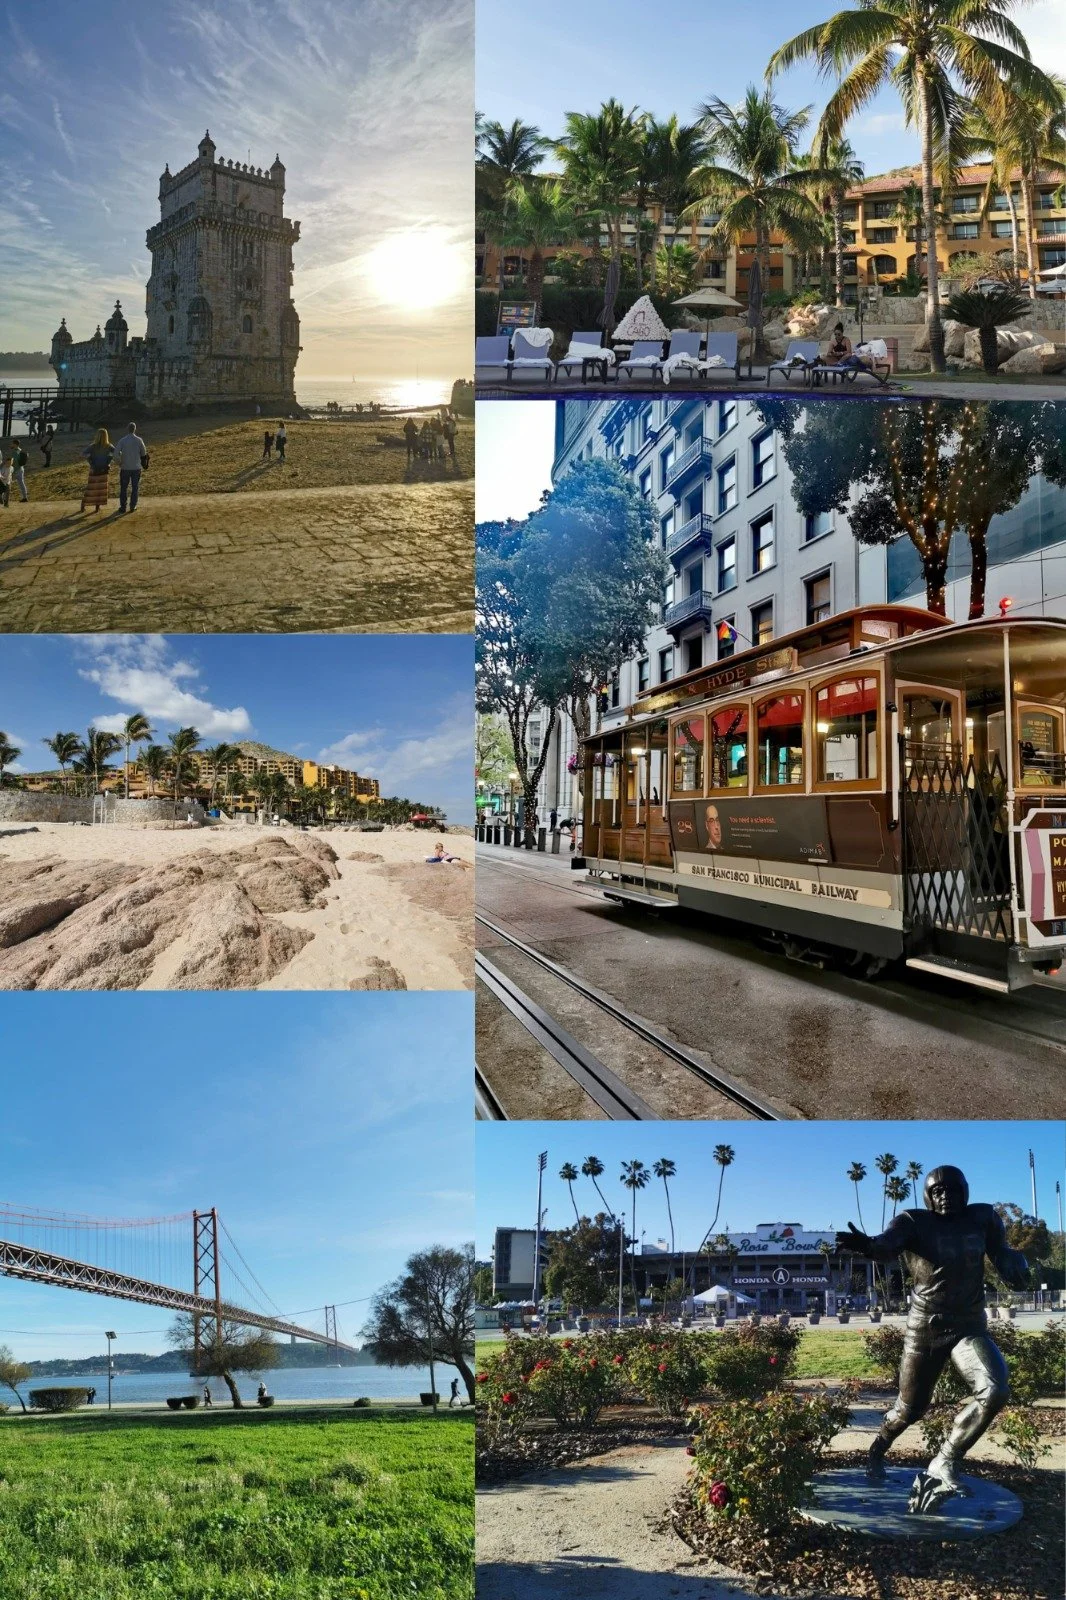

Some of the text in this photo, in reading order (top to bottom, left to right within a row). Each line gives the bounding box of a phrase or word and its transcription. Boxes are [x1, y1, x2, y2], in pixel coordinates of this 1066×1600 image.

[706, 666, 747, 689] HYDE
[677, 820, 693, 834] 28
[691, 865, 859, 901] SAN FRANCISCO MUNICIPAL RAILWAY
[1056, 880, 1066, 893] HY
[736, 1237, 823, 1252] Rose Bowl
